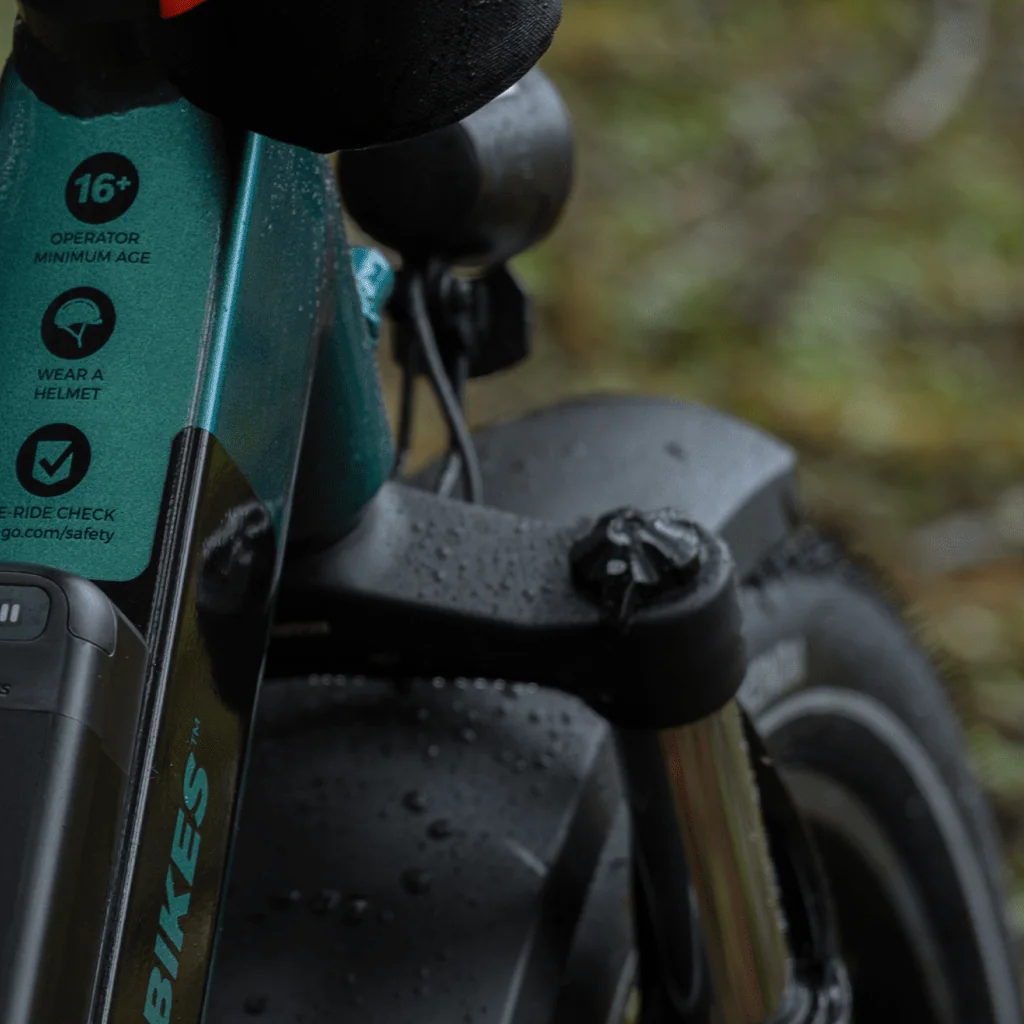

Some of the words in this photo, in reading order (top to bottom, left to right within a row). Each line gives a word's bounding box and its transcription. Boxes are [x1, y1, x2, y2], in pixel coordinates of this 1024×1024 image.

[75, 172, 132, 204] 16+
[50, 230, 140, 245] OPERATOR
[33, 250, 110, 264] MINIMUM
[114, 250, 151, 264] AGE
[37, 368, 87, 381] WEAR
[91, 368, 104, 381] A
[34, 387, 102, 401] HELMET
[58, 507, 115, 521] CHECK
